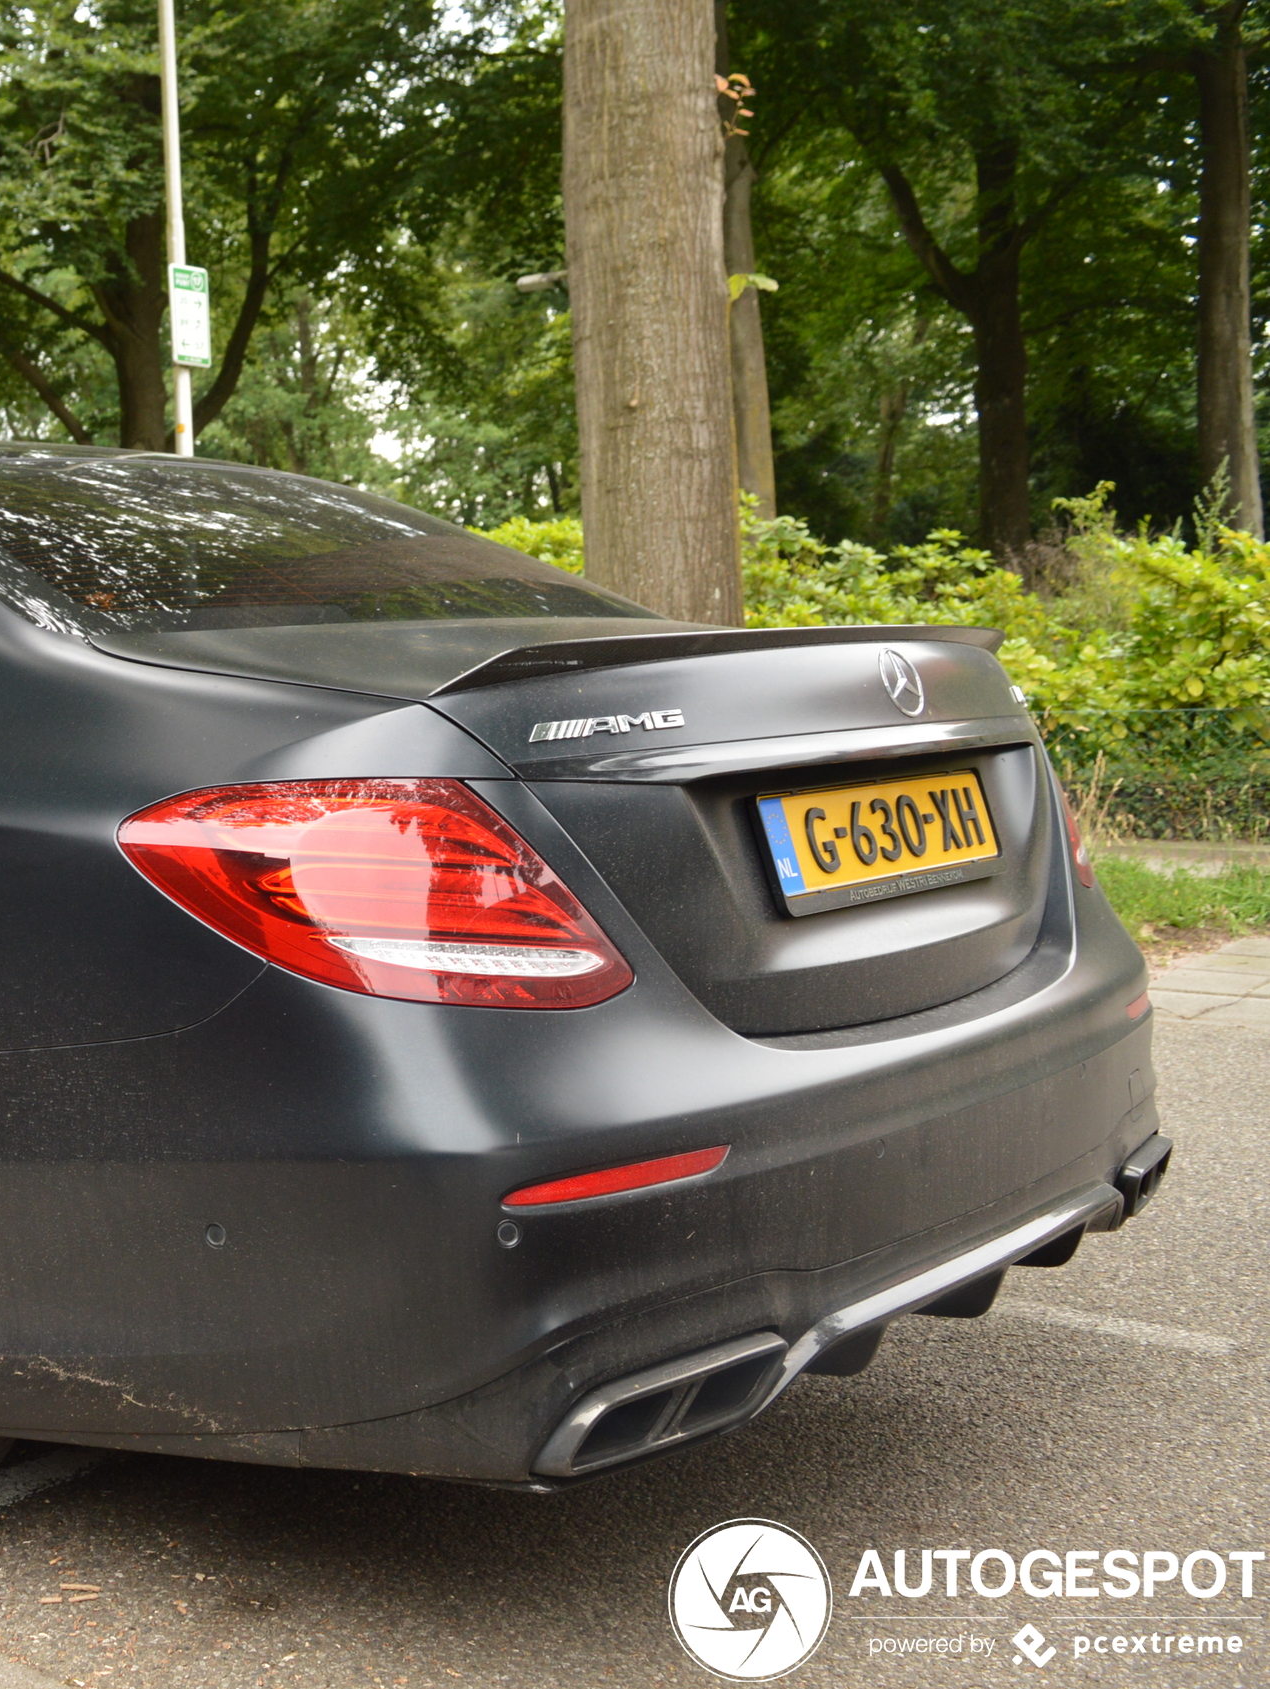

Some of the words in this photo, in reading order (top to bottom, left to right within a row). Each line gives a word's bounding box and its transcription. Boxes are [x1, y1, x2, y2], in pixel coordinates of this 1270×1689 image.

[582, 708, 686, 738] AMG
[804, 786, 986, 874] G-630-XH
[777, 857, 799, 879] NL
